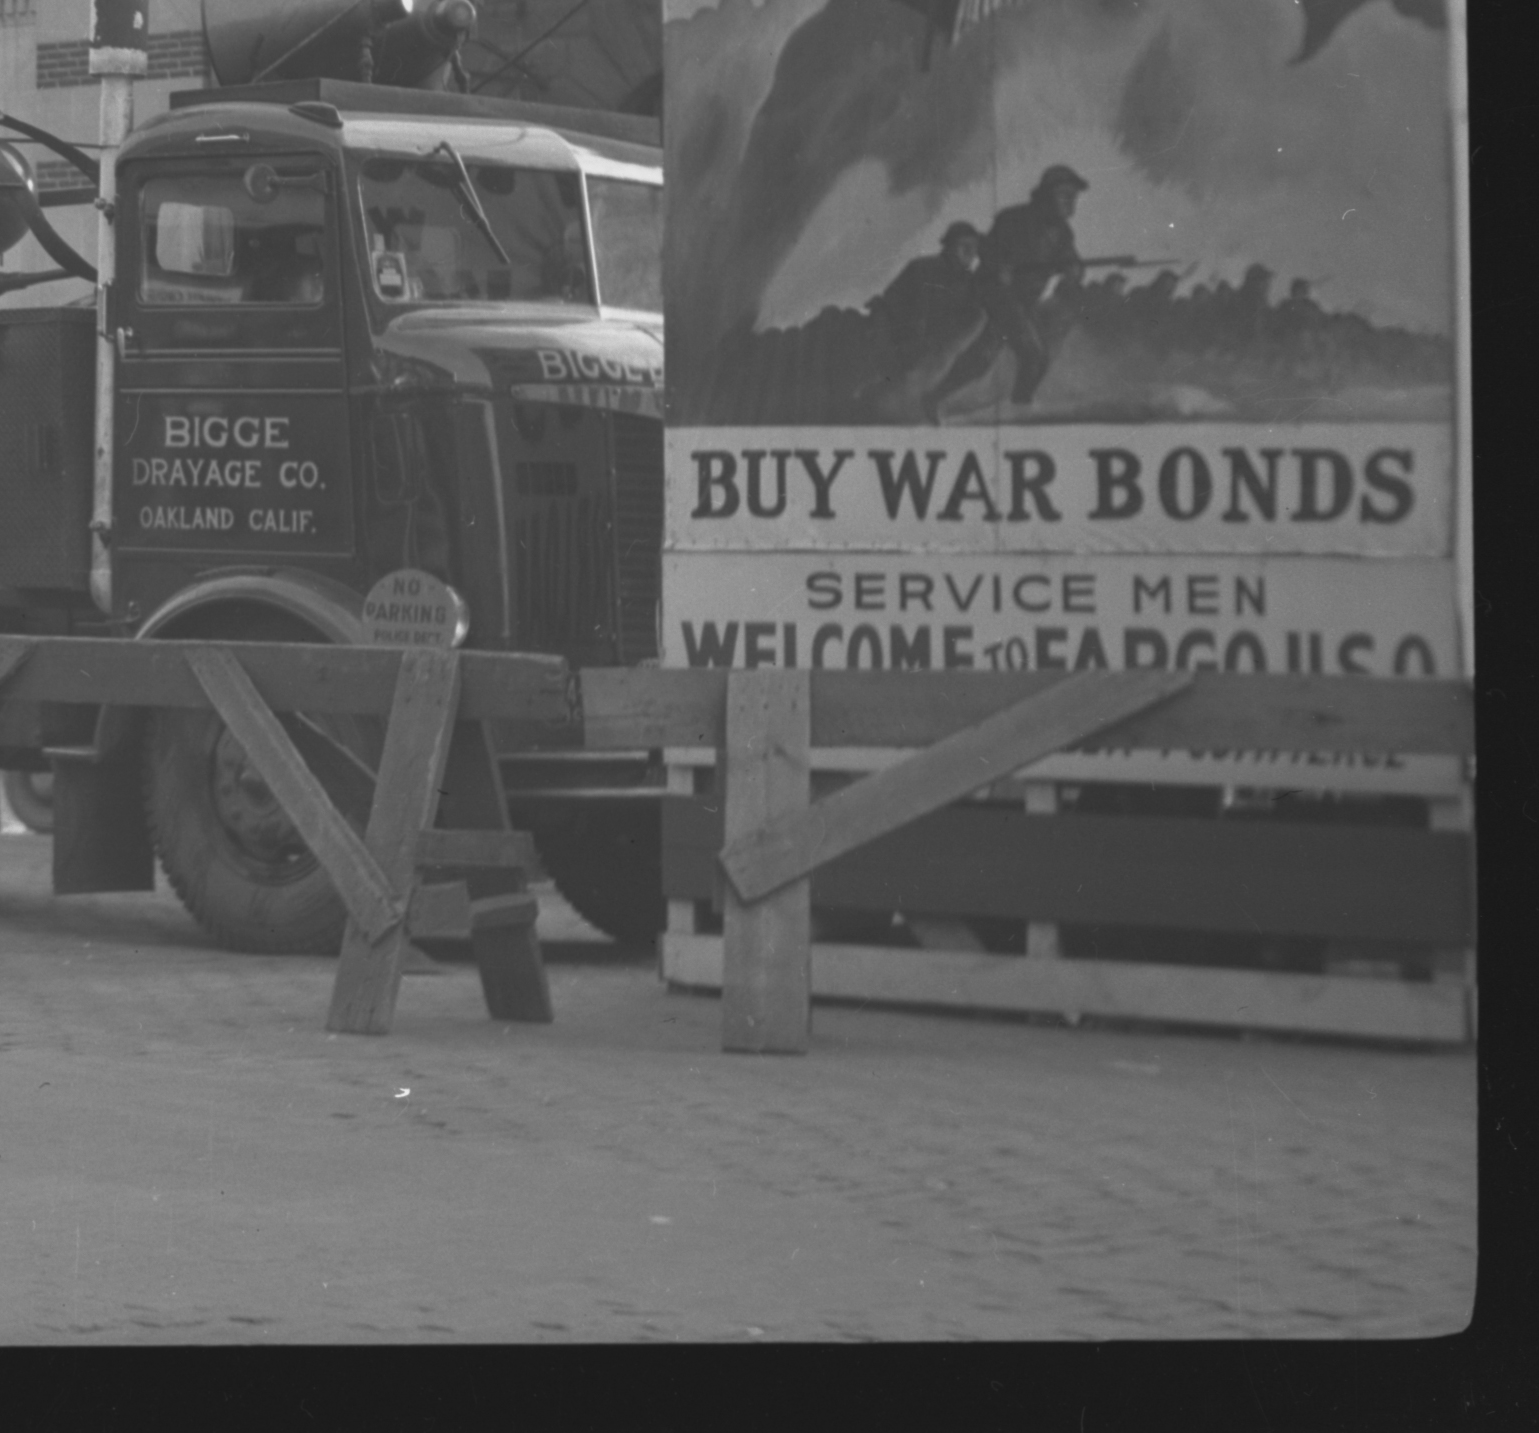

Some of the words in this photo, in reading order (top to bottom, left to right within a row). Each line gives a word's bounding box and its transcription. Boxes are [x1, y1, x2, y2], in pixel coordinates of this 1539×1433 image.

[164, 415, 290, 449] BIGGE
[131, 457, 262, 489] DRAYAGE
[279, 460, 326, 491] CO.
[690, 448, 855, 520] BUY
[867, 448, 1062, 523] WAR
[1087, 445, 1415, 525] BONDS
[139, 505, 235, 530] OAKLAND
[248, 508, 317, 534] CALIF.
[393, 577, 421, 596] NO
[805, 570, 1096, 613] SERVICE
[1133, 573, 1266, 616] MEN
[365, 601, 447, 625] PARKING
[681, 621, 974, 670] WELCOME
[984, 635, 1030, 670] TO
